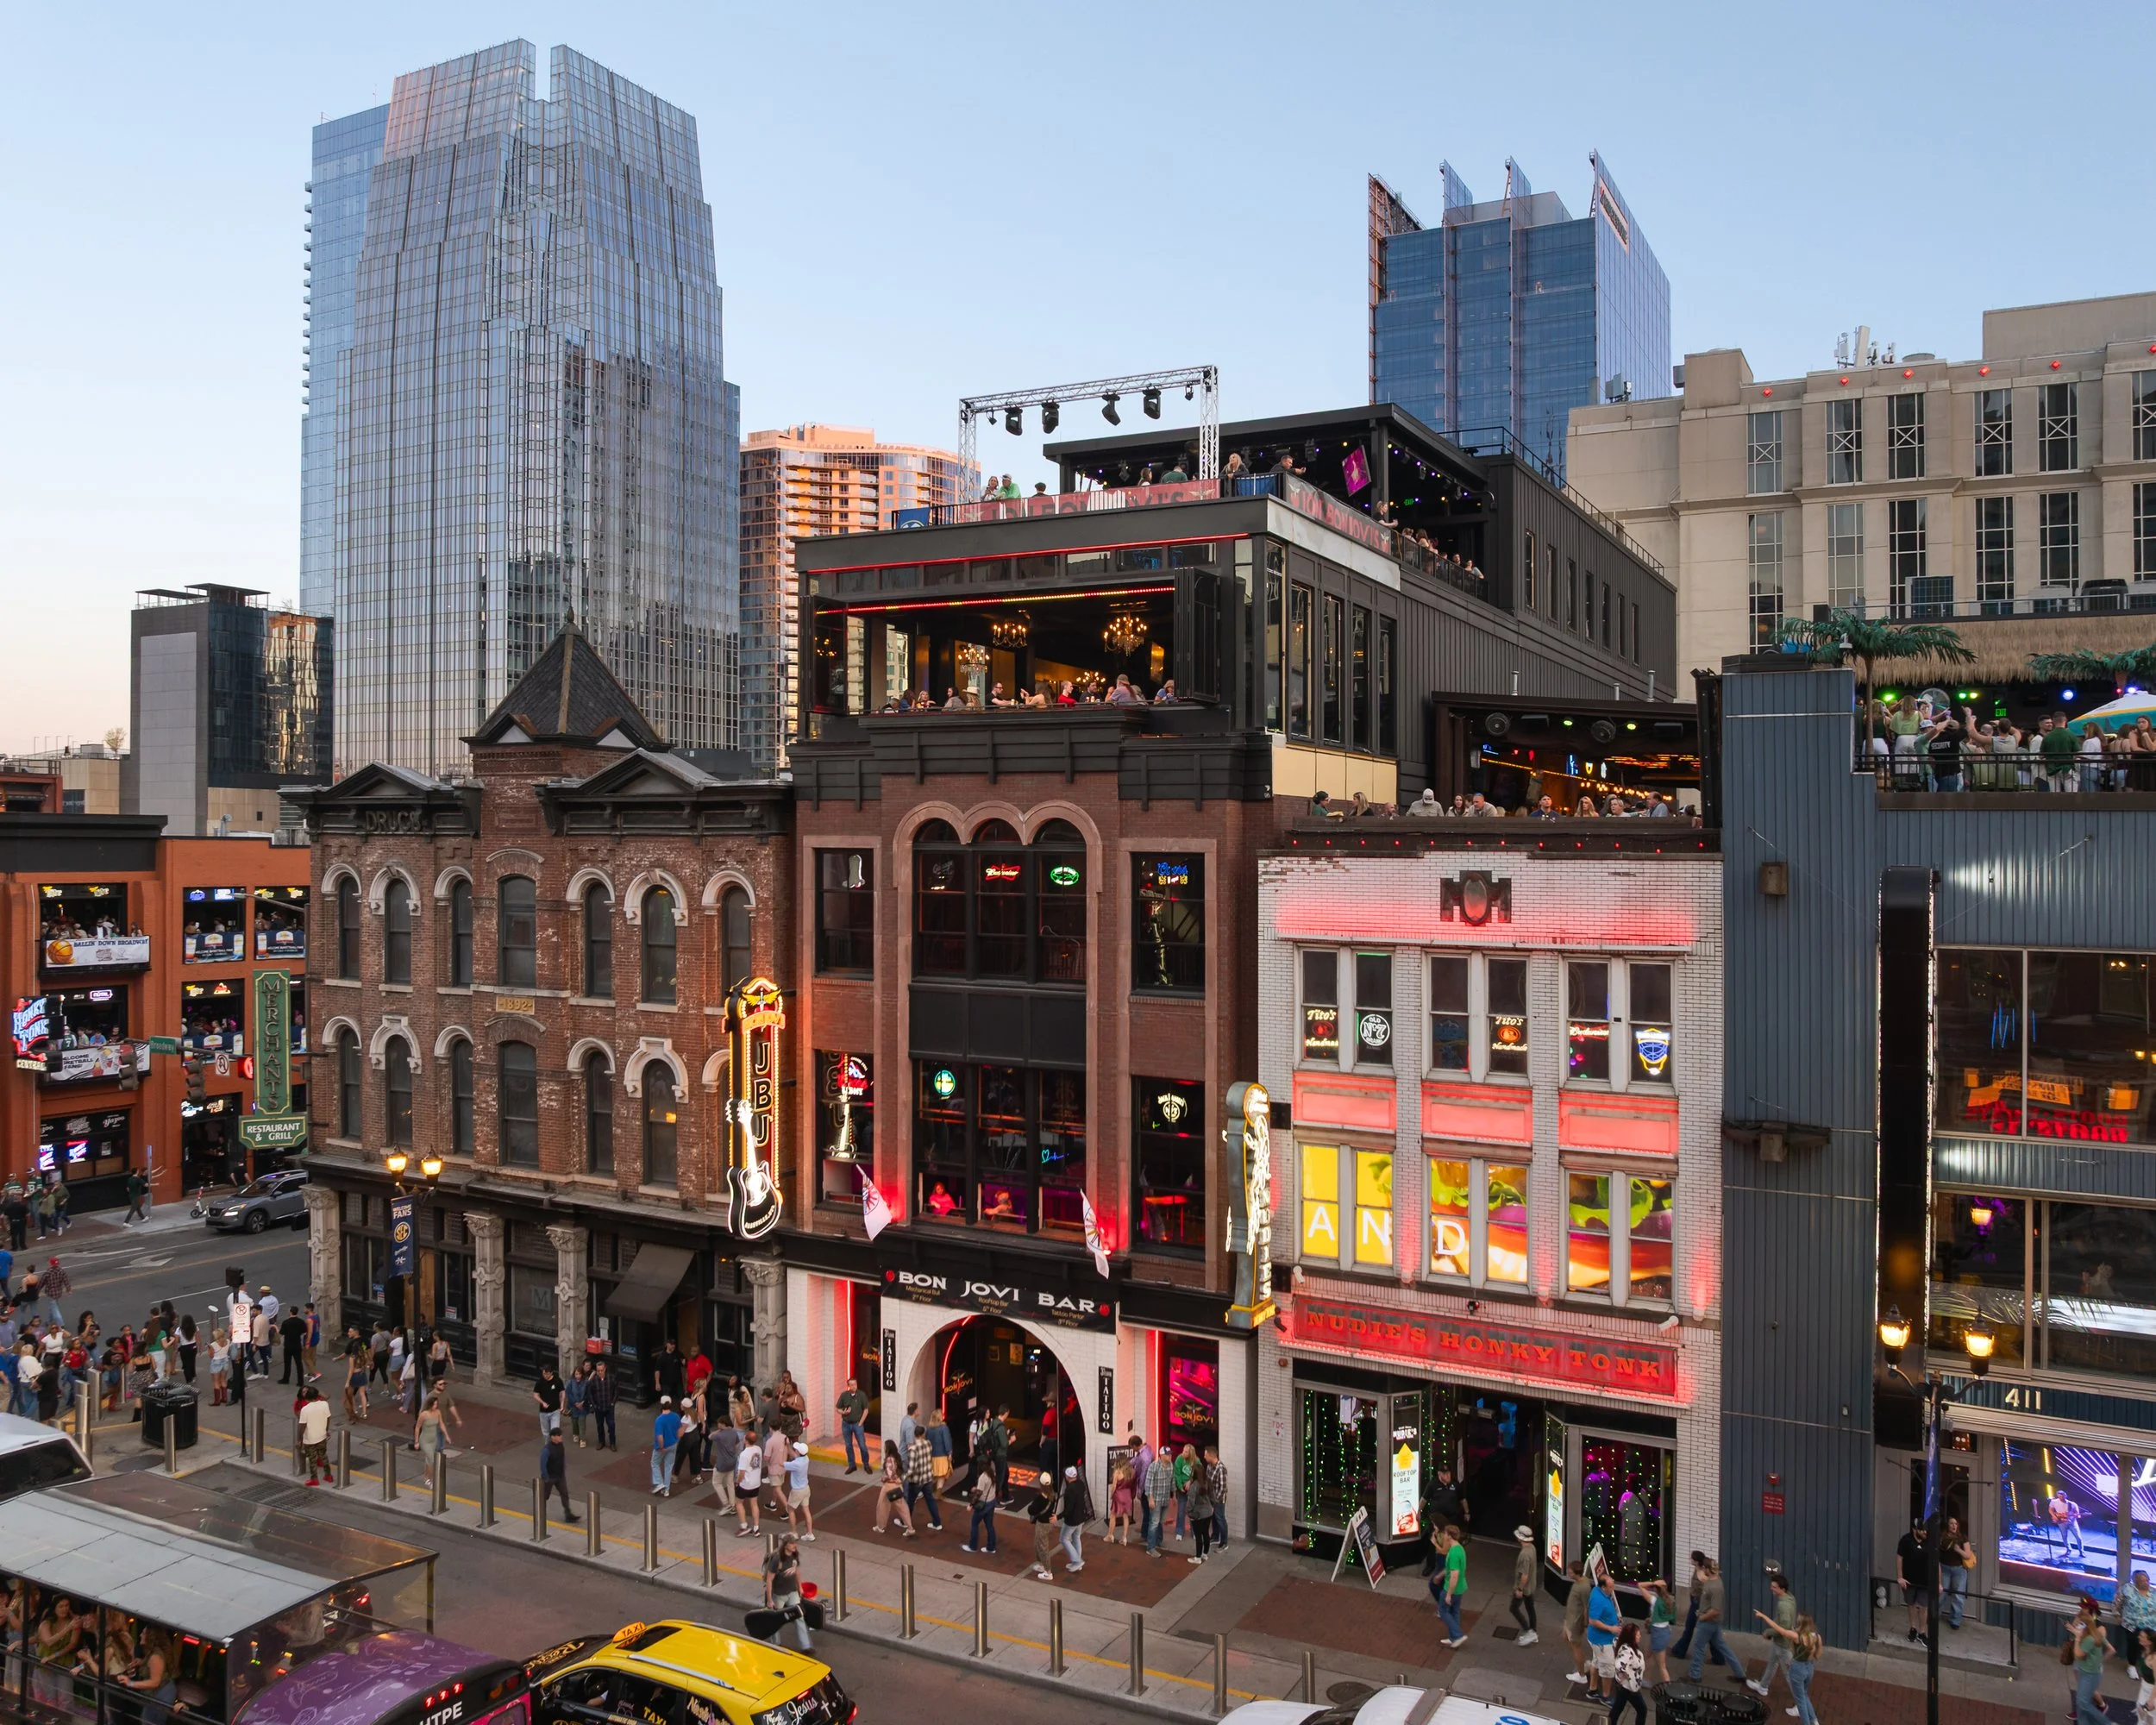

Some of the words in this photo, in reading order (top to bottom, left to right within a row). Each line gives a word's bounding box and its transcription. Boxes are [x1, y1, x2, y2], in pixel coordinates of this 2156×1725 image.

[1326, 504, 1348, 534] BON
[1995, 708, 2007, 717] EXIT
[365, 811, 422, 831] DRUGS
[13, 997, 47, 1034] HONKY
[1307, 1009, 1337, 1021] Tito's
[19, 1019, 49, 1052] TONK
[150, 1040, 174, 1051] Broadway
[262, 978, 280, 1110] MERCHANTS
[1306, 1037, 1339, 1047] Handmad
[754, 1041, 774, 1148] JBJ
[103, 1115, 125, 1128] Yazoo
[247, 1122, 301, 1134] RESTAURANT
[255, 1132, 262, 1142] &
[268, 1132, 293, 1141] GRILL
[393, 1208, 412, 1220] FANS
[899, 1270, 947, 1289] BON
[960, 1281, 1019, 1302] JOVI
[1037, 1292, 1096, 1314] BAR
[978, 1297, 999, 1307] Rooftop
[989, 1307, 1003, 1315] Floor
[1051, 1308, 1068, 1318] Tattoo
[1069, 1311, 1085, 1320] Parlor
[1307, 1311, 1426, 1344] NUDIE'S
[1440, 1331, 1553, 1364] HONKY
[1568, 1349, 1661, 1378] TONK
[862, 1352, 878, 1361] BON
[943, 1383, 957, 1394] BON
[2005, 1388, 2042, 1410] 411
[1174, 1410, 1192, 1420] BON
[1191, 1413, 1214, 1424] JOVI
[1393, 1427, 1417, 1439] NUDIE'S
[1109, 1449, 1134, 1459] TAOO
[1393, 1469, 1417, 1477] ROOFTOP
[621, 1622, 643, 1638] TAXI
[642, 1706, 667, 1725] TAXI
[786, 1697, 818, 1725] Jesus
